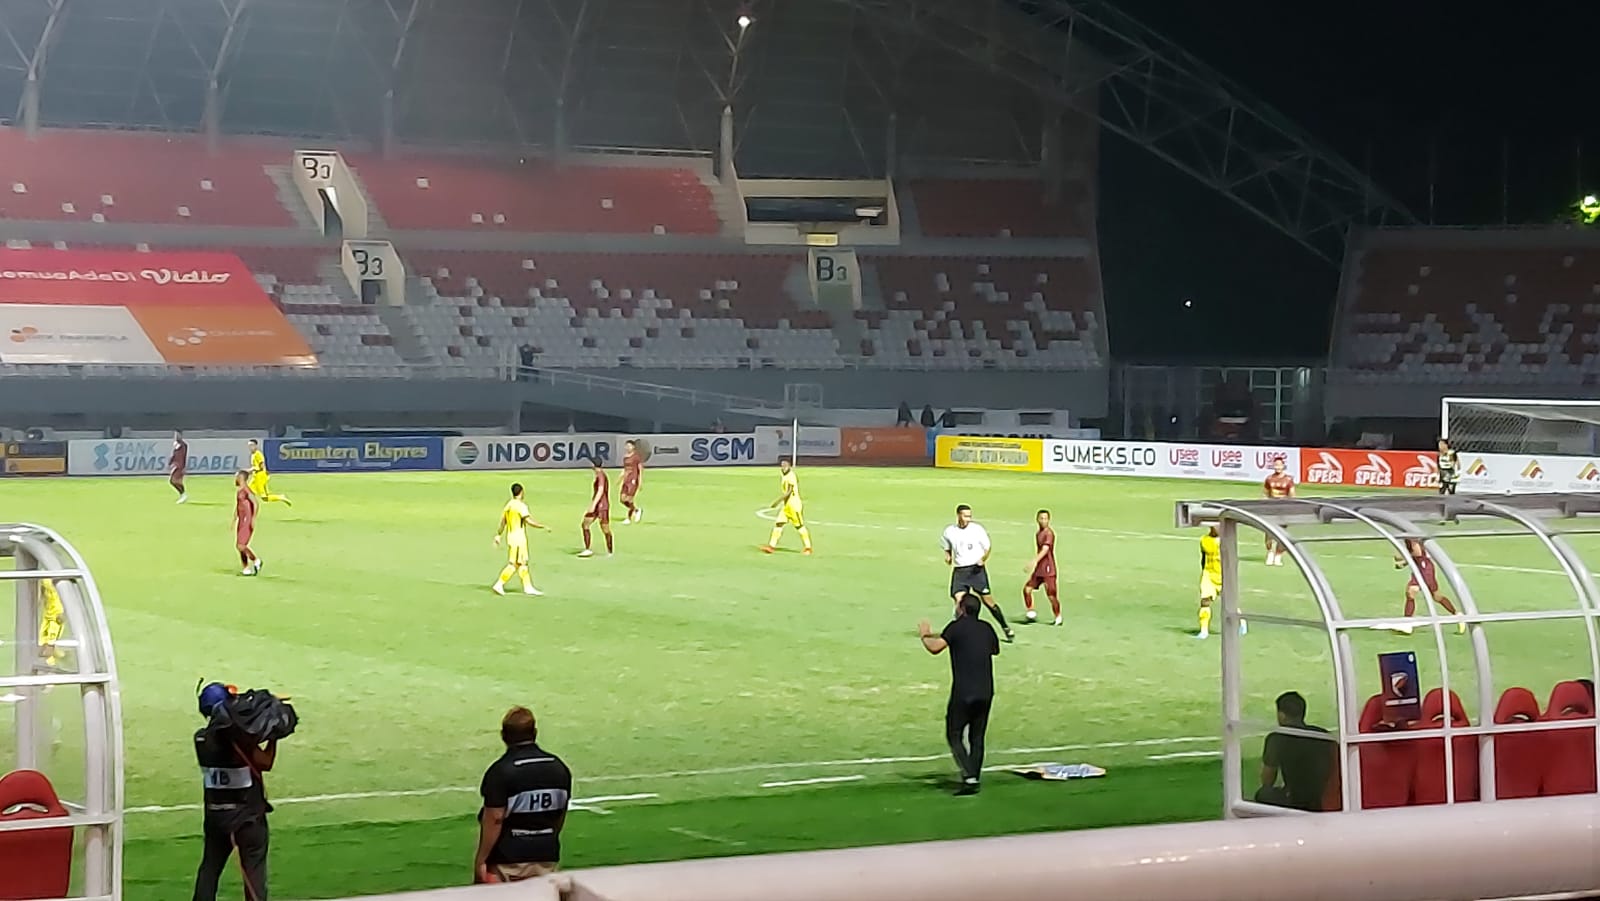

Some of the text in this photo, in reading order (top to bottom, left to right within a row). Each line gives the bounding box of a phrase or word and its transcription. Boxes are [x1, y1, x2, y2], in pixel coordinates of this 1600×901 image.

[0, 269, 231, 285] emuaAdaDi Vidio
[816, 256, 847, 281] B3
[115, 442, 158, 455] BANK
[279, 442, 428, 461] Sumatera Ekspres
[487, 442, 610, 462] INDOSIAR
[691, 437, 755, 461] SCM
[1053, 445, 1156, 466] SUMEKS.CO
[1307, 469, 1343, 483] SPECS
[1355, 470, 1392, 485] SPECS
[530, 792, 553, 811] HB
